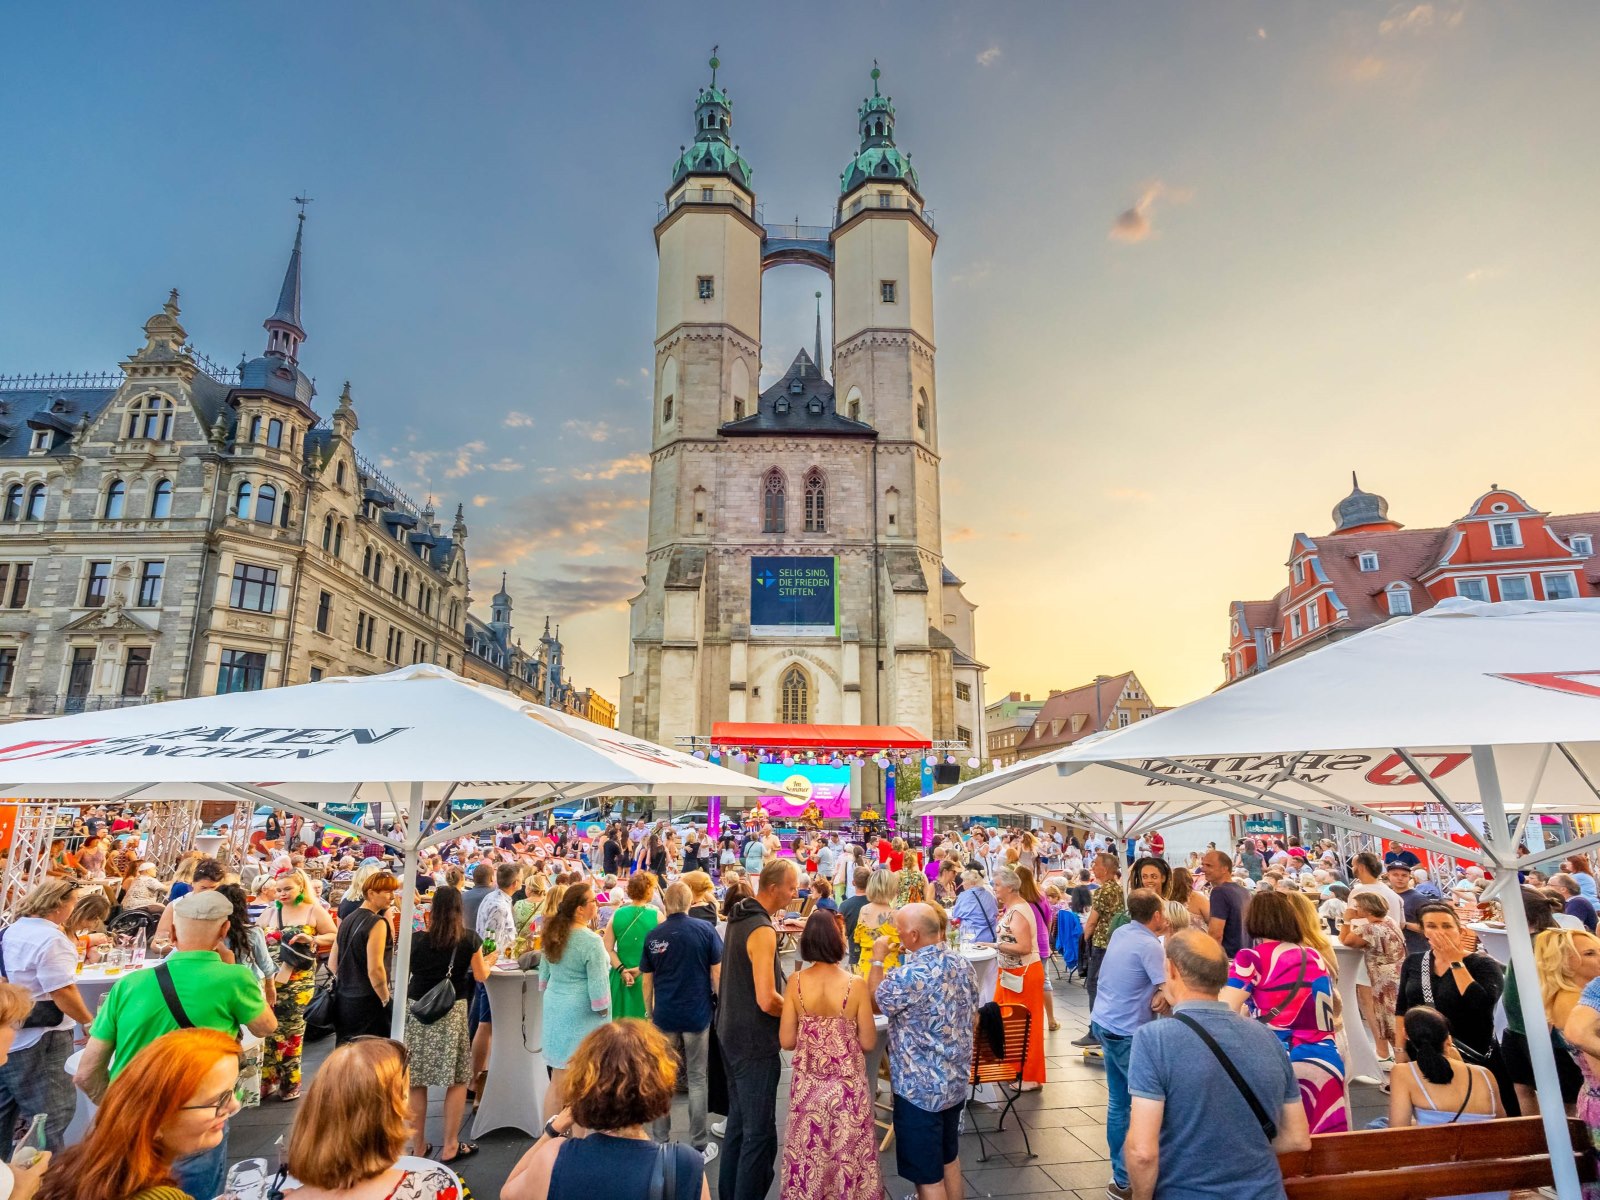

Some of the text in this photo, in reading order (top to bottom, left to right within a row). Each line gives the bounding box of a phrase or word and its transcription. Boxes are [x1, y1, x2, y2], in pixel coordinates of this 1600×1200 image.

[779, 568, 828, 578] SELIG SIND,
[779, 578, 830, 587] DIE FRIEDEN
[779, 587, 817, 596] STIFTEN.
